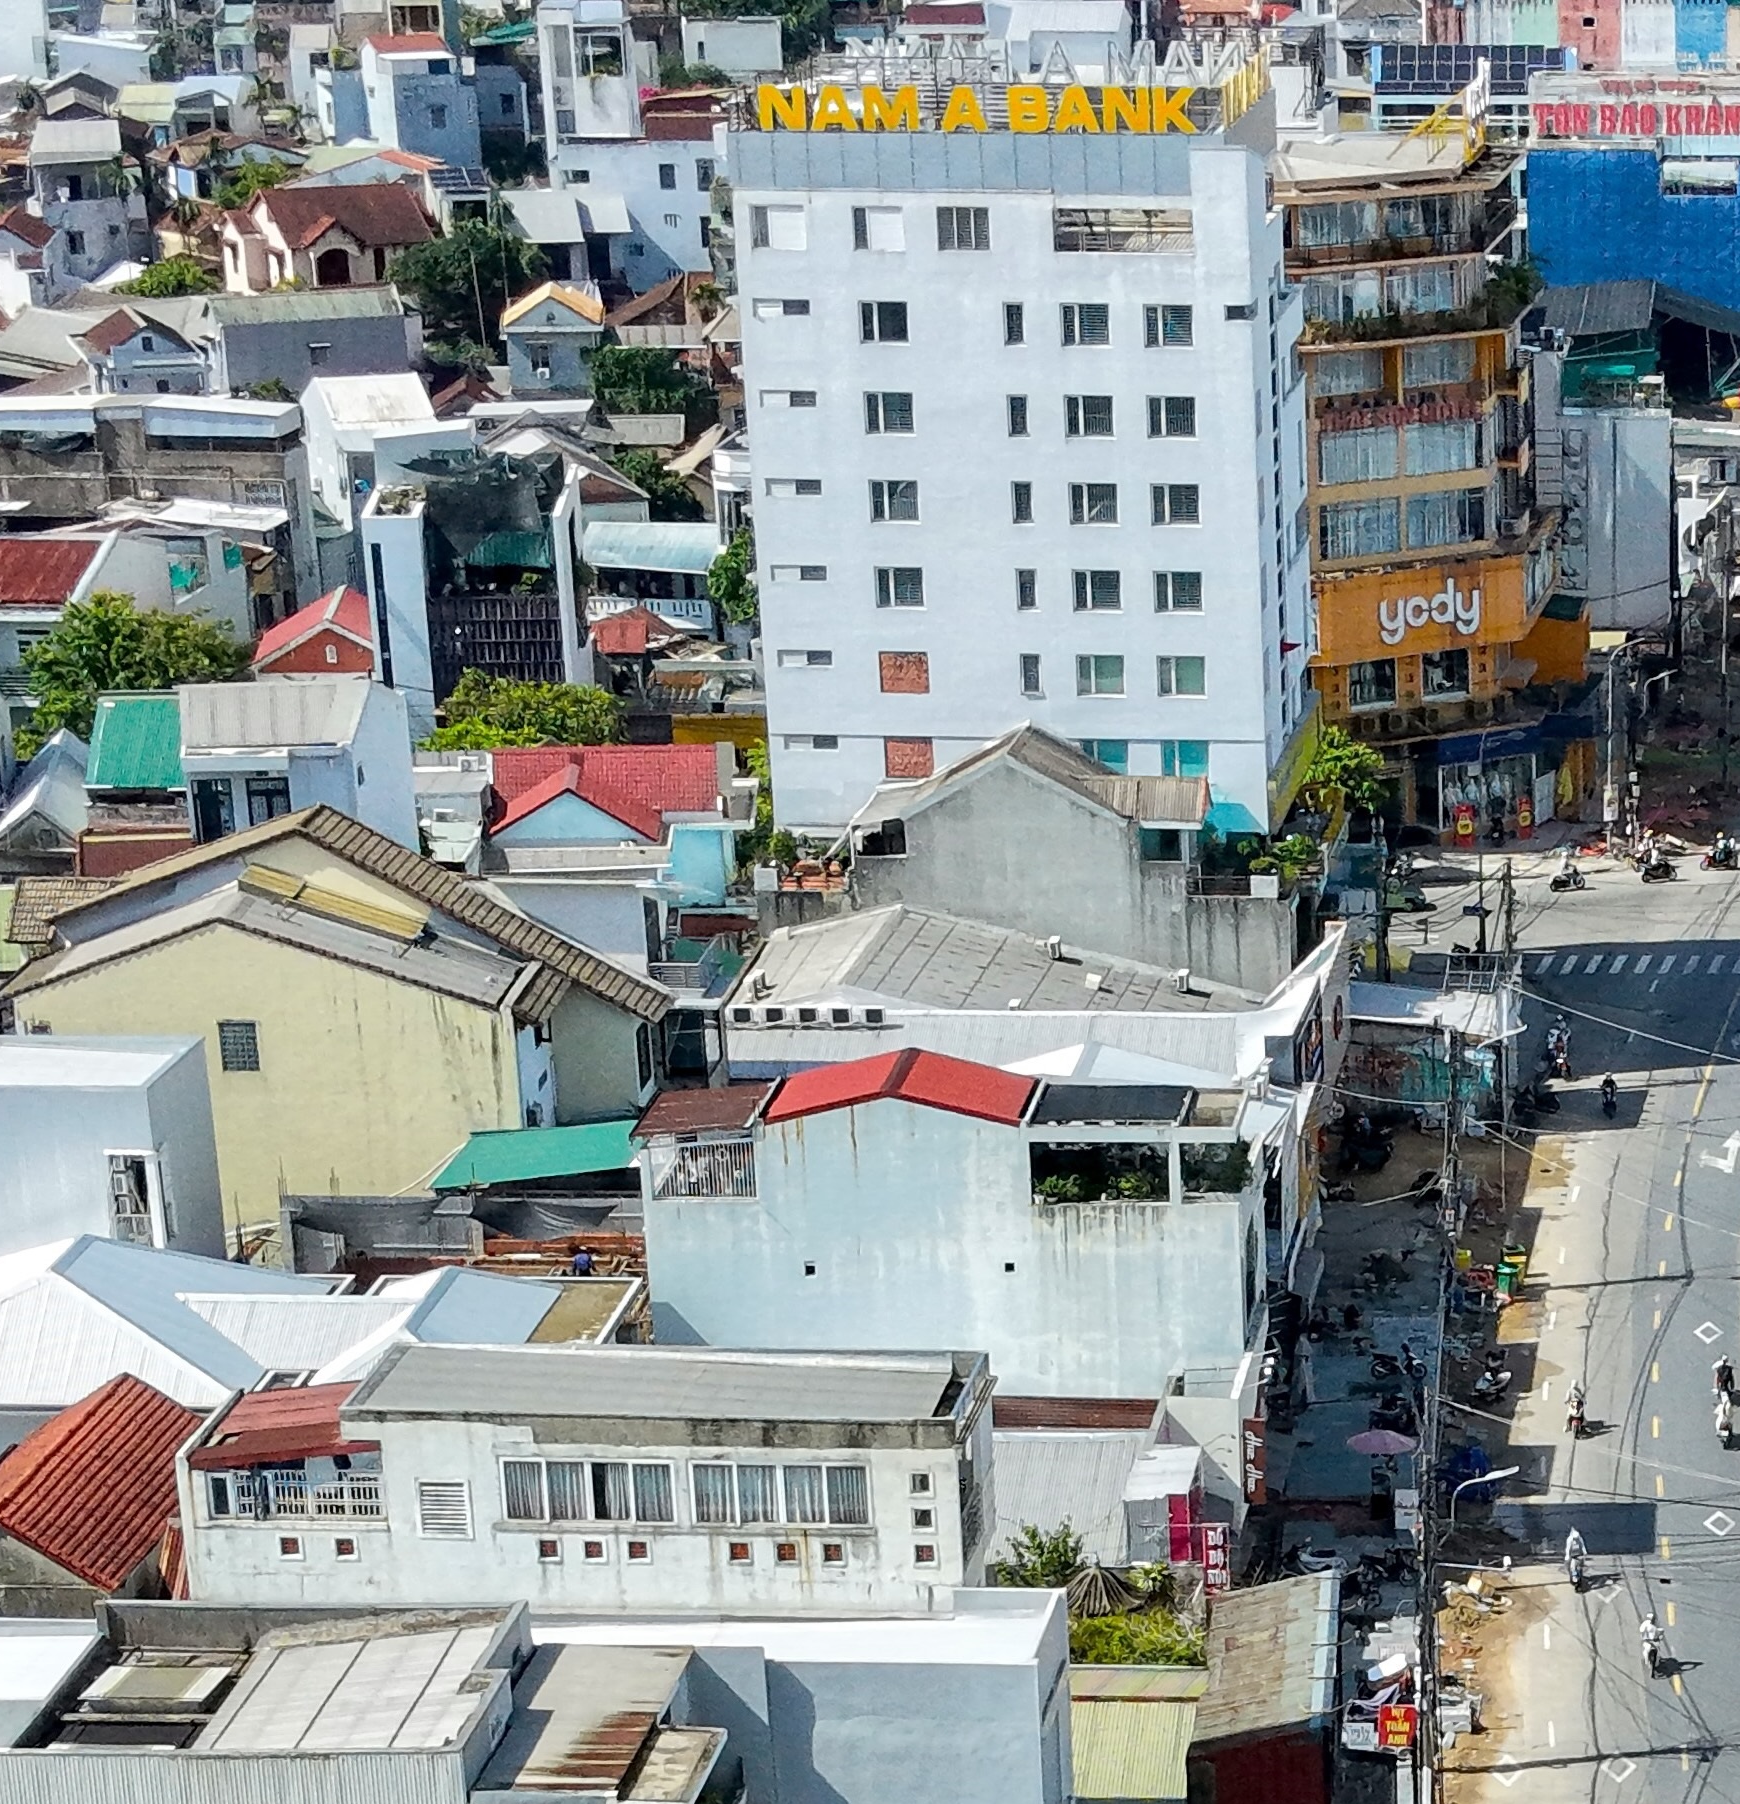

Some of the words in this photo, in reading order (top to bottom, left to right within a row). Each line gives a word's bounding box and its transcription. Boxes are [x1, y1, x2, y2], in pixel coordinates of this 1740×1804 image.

[757, 84, 921, 132] NAM
[941, 84, 990, 132] A
[1006, 85, 1199, 134] BANK
[1379, 576, 1481, 646] yody
